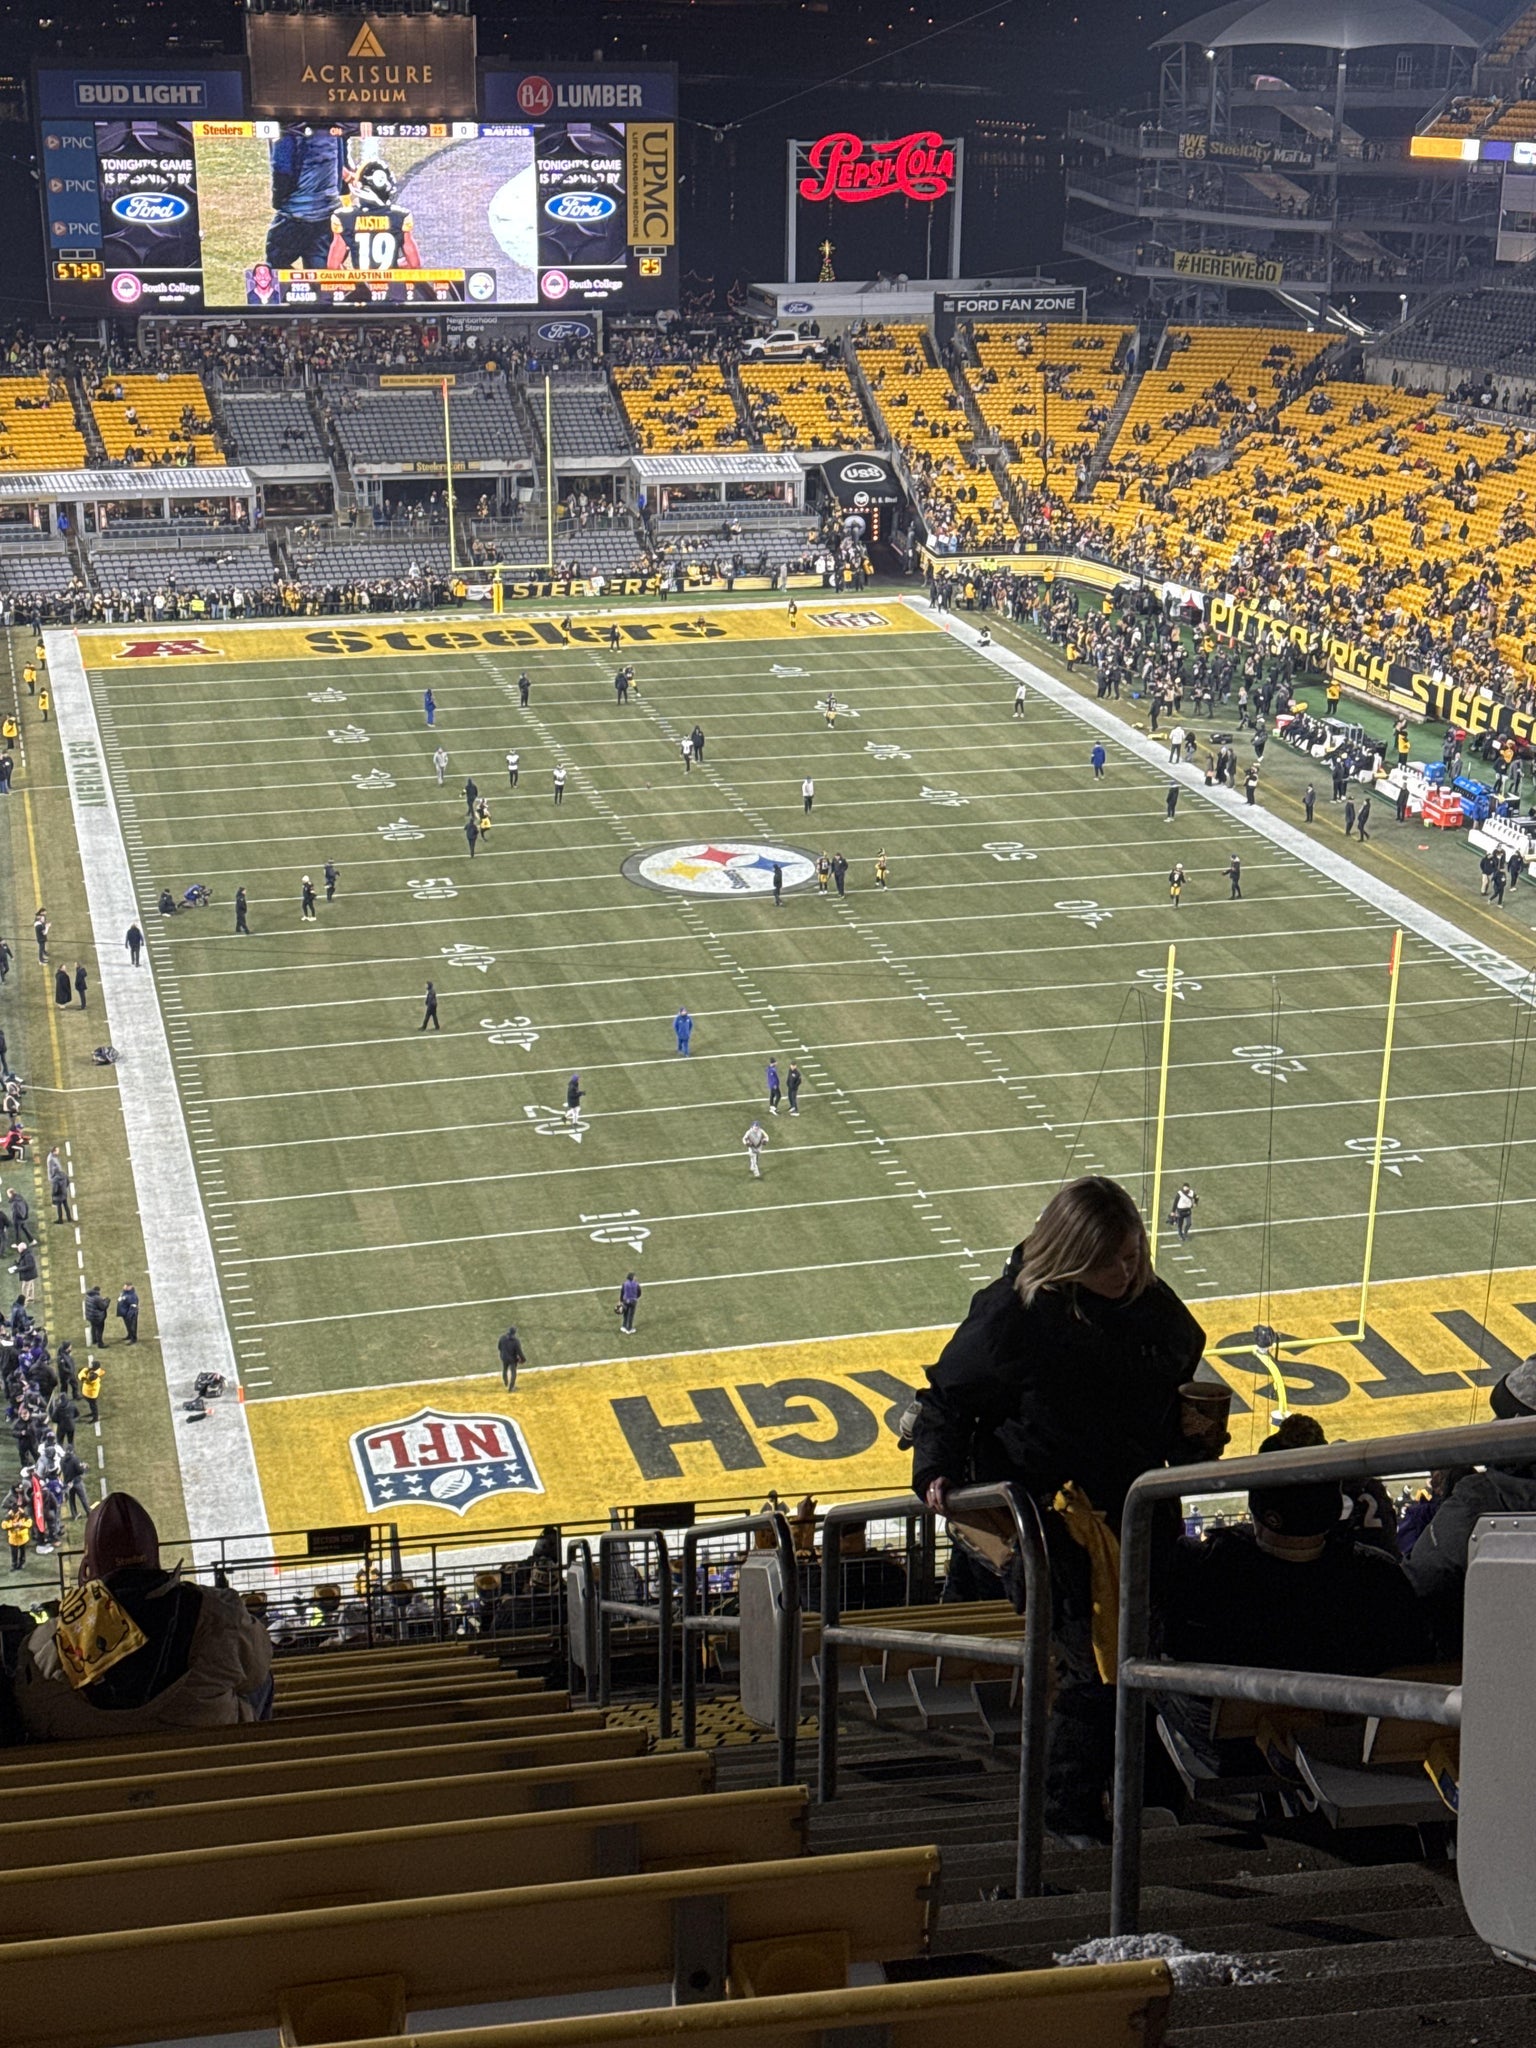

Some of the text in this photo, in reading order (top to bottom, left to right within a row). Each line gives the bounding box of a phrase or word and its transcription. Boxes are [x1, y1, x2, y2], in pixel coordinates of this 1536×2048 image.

[301, 65, 433, 84] ACRISURE
[78, 84, 202, 104] BUD LIGHT
[328, 89, 407, 102] STADIUM
[521, 84, 643, 107] 84 LUMBER
[203, 124, 243, 136] Steelers
[263, 125, 270, 135] 0
[376, 125, 428, 136] 1ST 57:39
[461, 126, 467, 135] 0
[483, 129, 530, 137] RAVENS
[62, 136, 93, 149] PNC
[1186, 133, 1208, 148] WE
[160, 159, 193, 171] GAME
[591, 159, 622, 171] GAME
[65, 180, 96, 192] PNC
[104, 173, 116, 184] IS
[177, 173, 192, 184] BY
[539, 173, 549, 184] IS
[607, 173, 620, 184] BY
[643, 129, 669, 239] UPMC
[126, 196, 175, 218] Ford
[558, 196, 603, 217] Ford
[68, 223, 100, 235] PNC
[355, 215, 390, 231] AUSTIN
[354, 232, 396, 270] 19
[57, 263, 101, 280] 57:39
[320, 272, 346, 280] CALVIN
[348, 271, 382, 280] AUSTIN
[641, 259, 660, 275] 25
[1176, 255, 1278, 282] #HEREWEGO
[142, 282, 200, 295] South College
[569, 278, 623, 290] South College
[958, 298, 1076, 312] FORD FAN ZONE
[446, 317, 498, 325] Neighborhood
[846, 467, 881, 478] USS
[511, 578, 658, 599] STEEERS
[305, 621, 729, 654] Steelers
[1210, 597, 1391, 686] PITTSBRGH
[327, 728, 371, 744] 20
[863, 744, 912, 760] 30
[67, 741, 109, 808] AMERICA 250
[351, 772, 397, 789] 30
[919, 790, 970, 807] 40
[1449, 815, 1457, 824] G
[377, 823, 425, 841] 40
[981, 841, 1038, 862] 50
[406, 877, 458, 900] 50
[1053, 899, 1113, 922] 40
[440, 943, 496, 967] 40
[1447, 943, 1515, 971] 250
[1135, 967, 1202, 993] 30
[479, 1015, 540, 1045] 30
[1231, 1044, 1308, 1075] 20
[523, 1102, 591, 1135] 20
[1343, 1136, 1424, 1164] 10
[579, 1208, 651, 1244] 10
[368, 1421, 508, 1469] NFL
